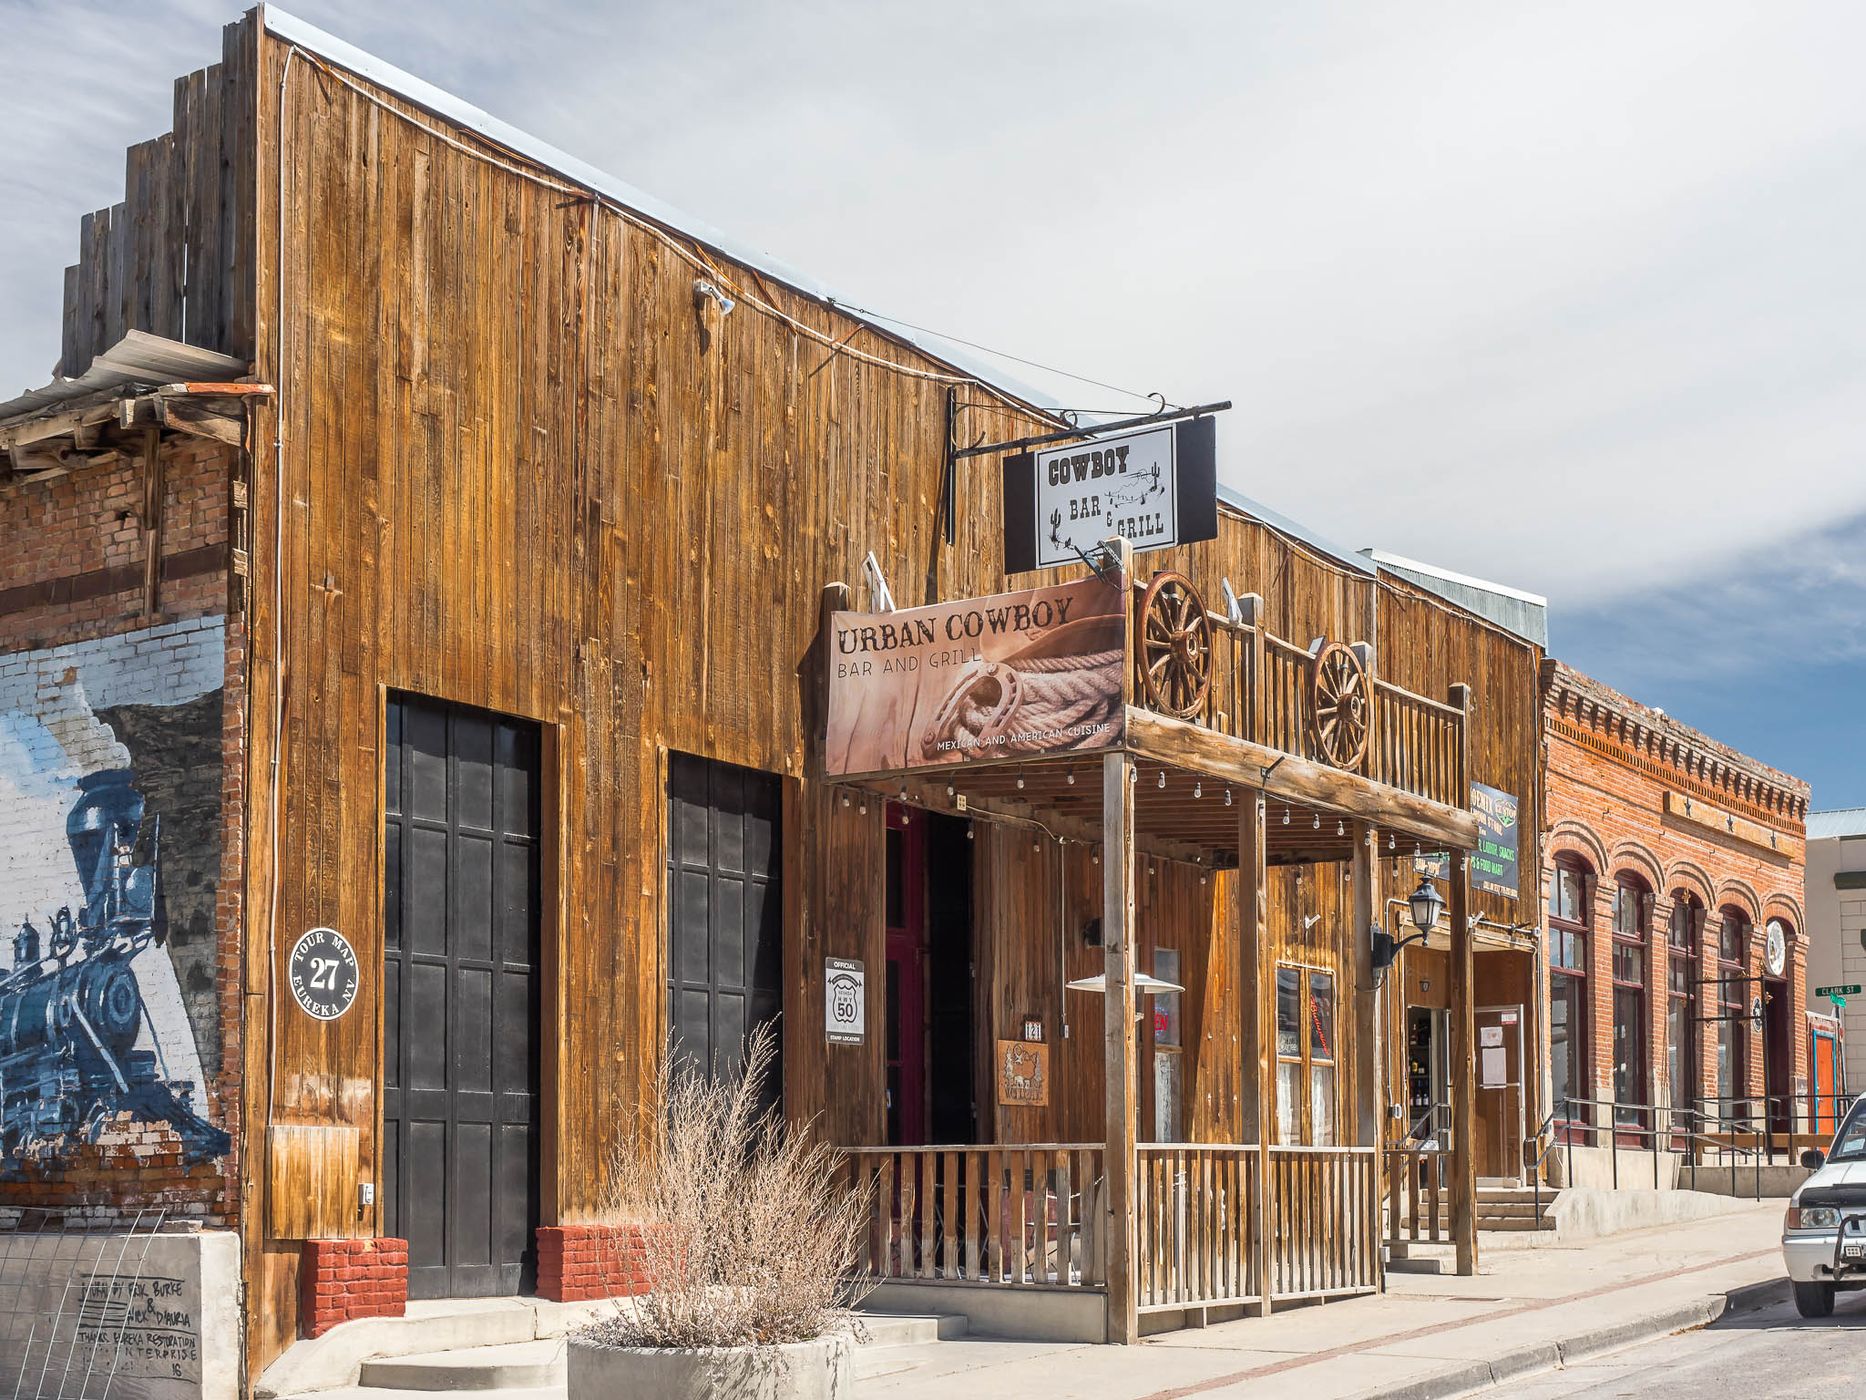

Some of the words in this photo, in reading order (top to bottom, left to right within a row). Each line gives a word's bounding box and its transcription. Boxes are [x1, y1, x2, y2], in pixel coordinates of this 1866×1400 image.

[1049, 445, 1130, 487] COWBOY
[1069, 495, 1101, 520] BAR
[1106, 511, 1112, 527] &
[1117, 512, 1164, 539] GRILL
[837, 617, 937, 655] URBAN
[945, 597, 1073, 641] COWBOY
[837, 663, 872, 678] BAR
[883, 656, 918, 674] AND
[930, 647, 982, 669] GRILL
[937, 737, 982, 752] MEXICAN
[986, 735, 1007, 747] AND
[1010, 728, 1063, 743] AMERICAN
[1068, 723, 1111, 738] CUISINE
[294, 932, 325, 962] TOUR
[331, 936, 355, 967] MAP
[310, 957, 340, 990] 27
[833, 961, 856, 970] OFFICIAL
[293, 975, 340, 1016] EUREKA
[342, 979, 355, 1003] NV
[1821, 987, 1844, 995] CLARK
[837, 1003, 853, 1017] 50
[152, 1281, 183, 1297] BURKE
[147, 1298, 156, 1315] &
[146, 1333, 196, 1348] RESTORATION
